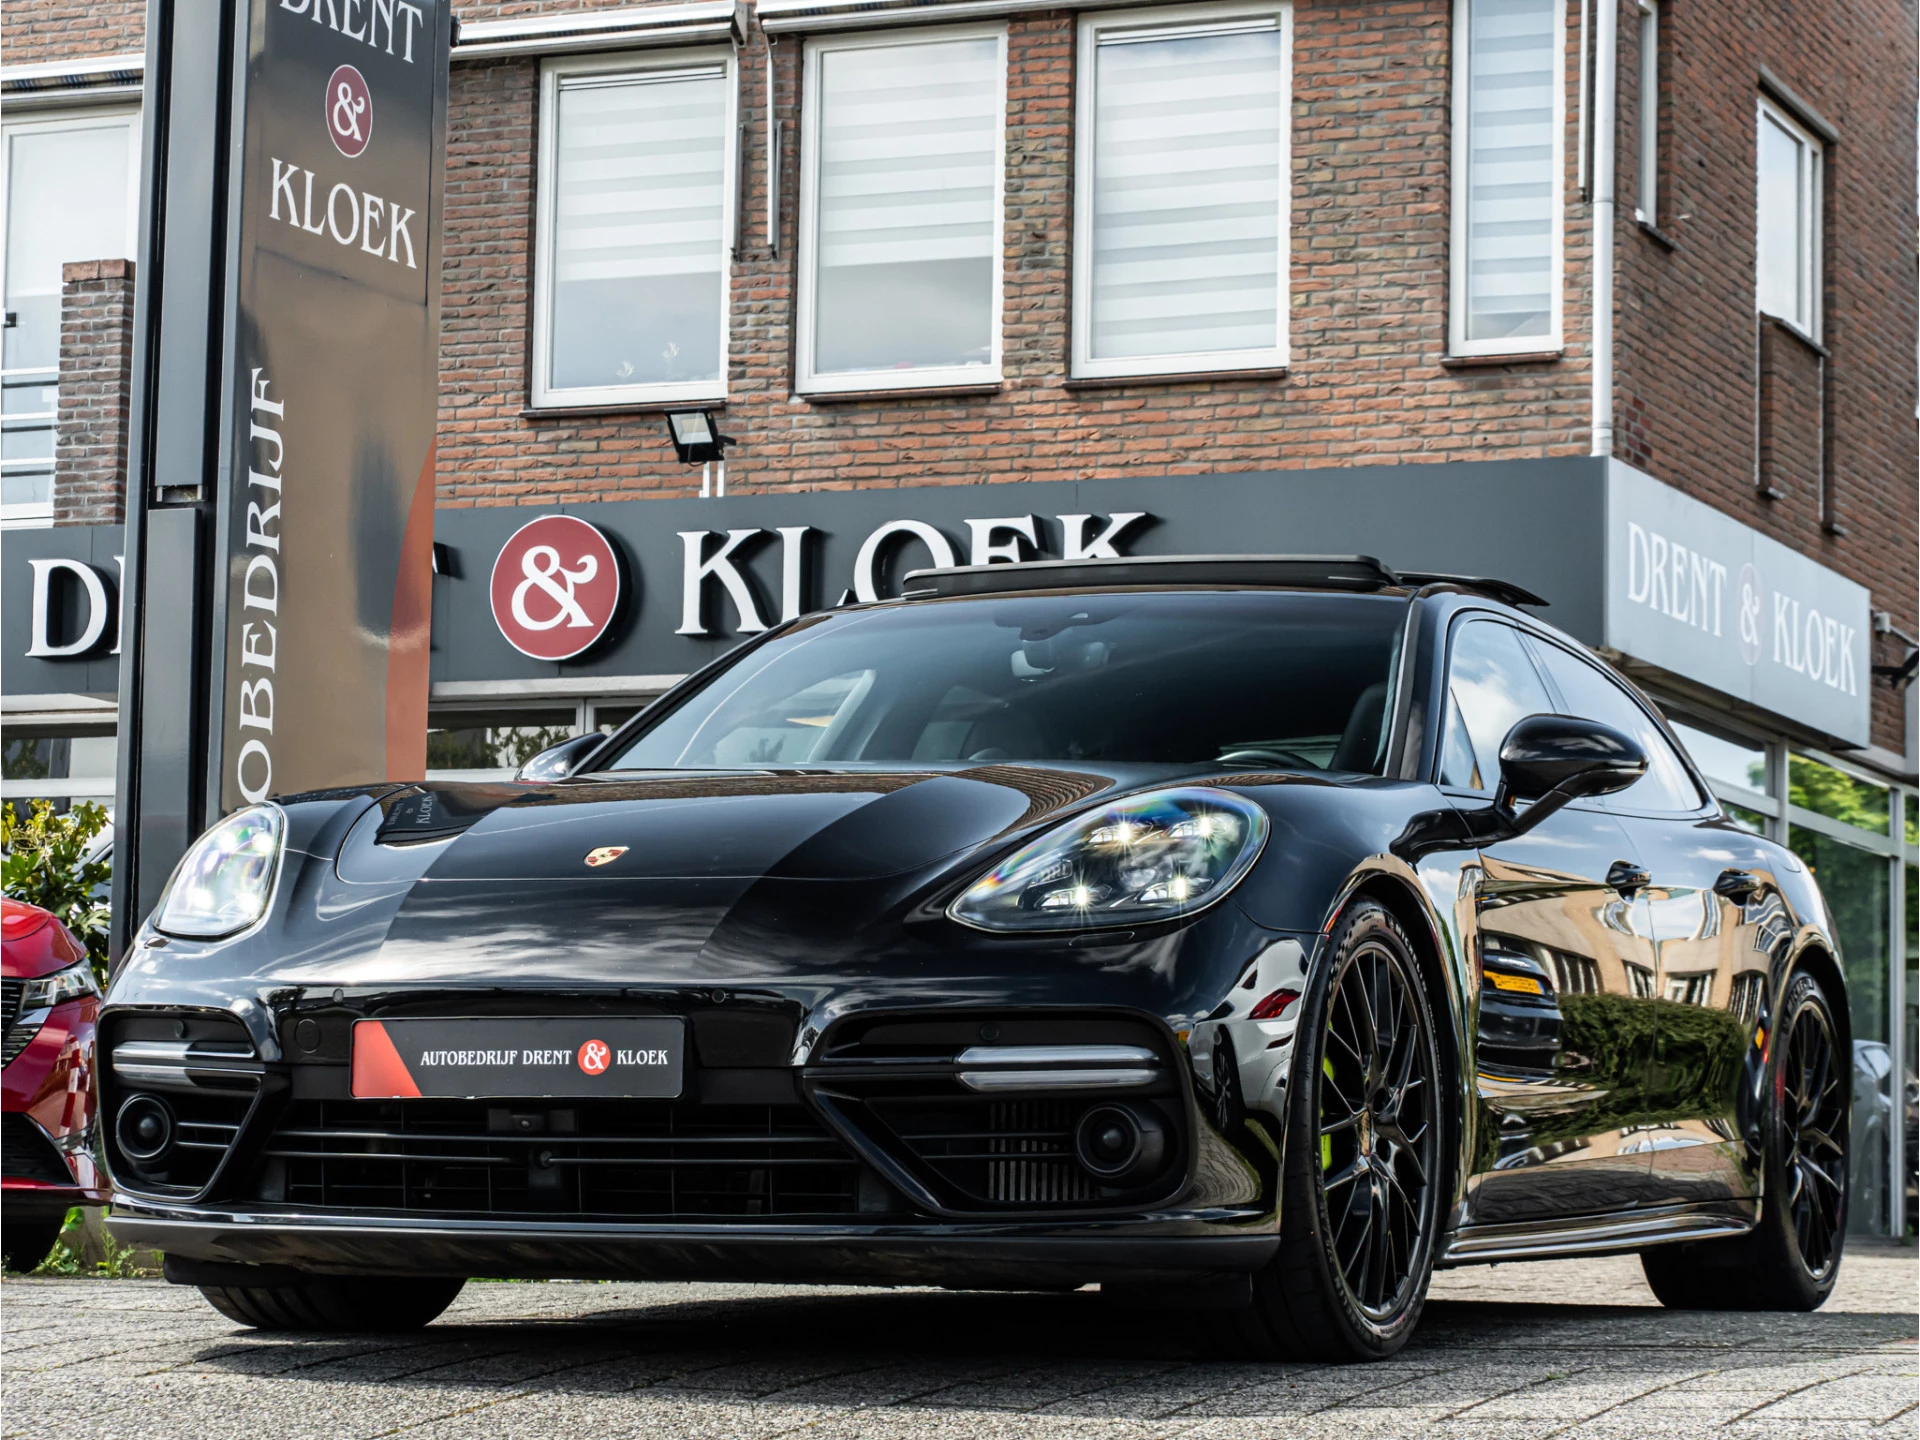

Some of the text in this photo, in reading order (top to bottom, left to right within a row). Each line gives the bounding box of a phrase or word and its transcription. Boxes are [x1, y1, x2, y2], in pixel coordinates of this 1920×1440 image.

[280, 0, 423, 63] ENT
[333, 82, 365, 142] &
[269, 157, 417, 269] KLOEK
[511, 545, 598, 631] &
[1628, 521, 1857, 697] DRENT & KLOEK
[420, 1043, 668, 1070] AUTOBEDRIJF DRENT & KLOEK
